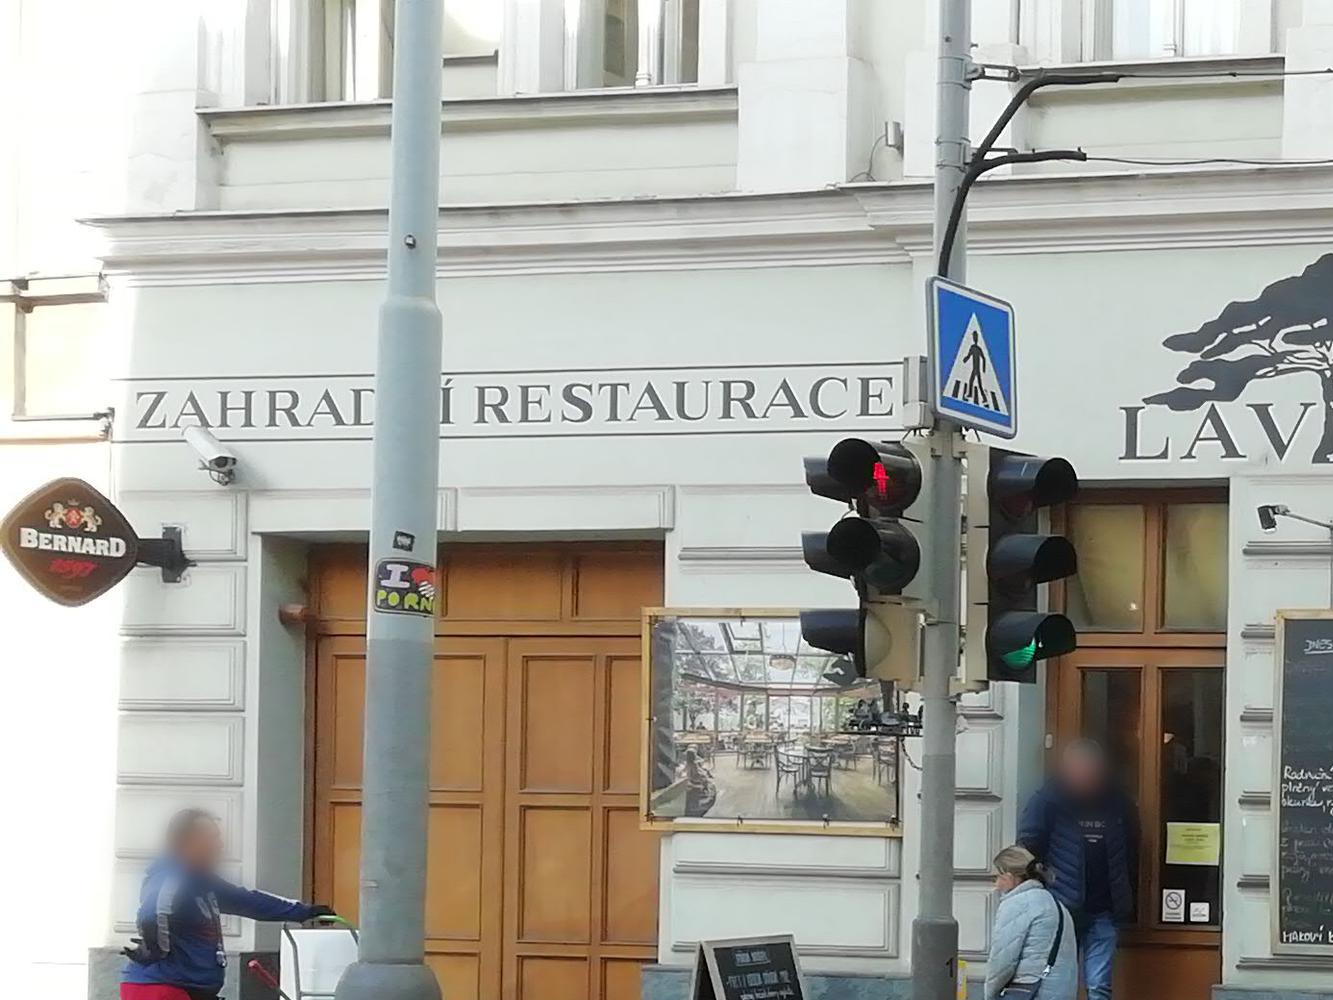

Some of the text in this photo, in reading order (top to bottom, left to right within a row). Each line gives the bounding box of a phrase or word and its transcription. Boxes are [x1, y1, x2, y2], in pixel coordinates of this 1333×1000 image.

[136, 376, 894, 429] ZAHRADÍ RESTAURACE
[20, 528, 126, 558] BERNARD
[381, 564, 410, 588] I
[377, 590, 434, 611] PORN
